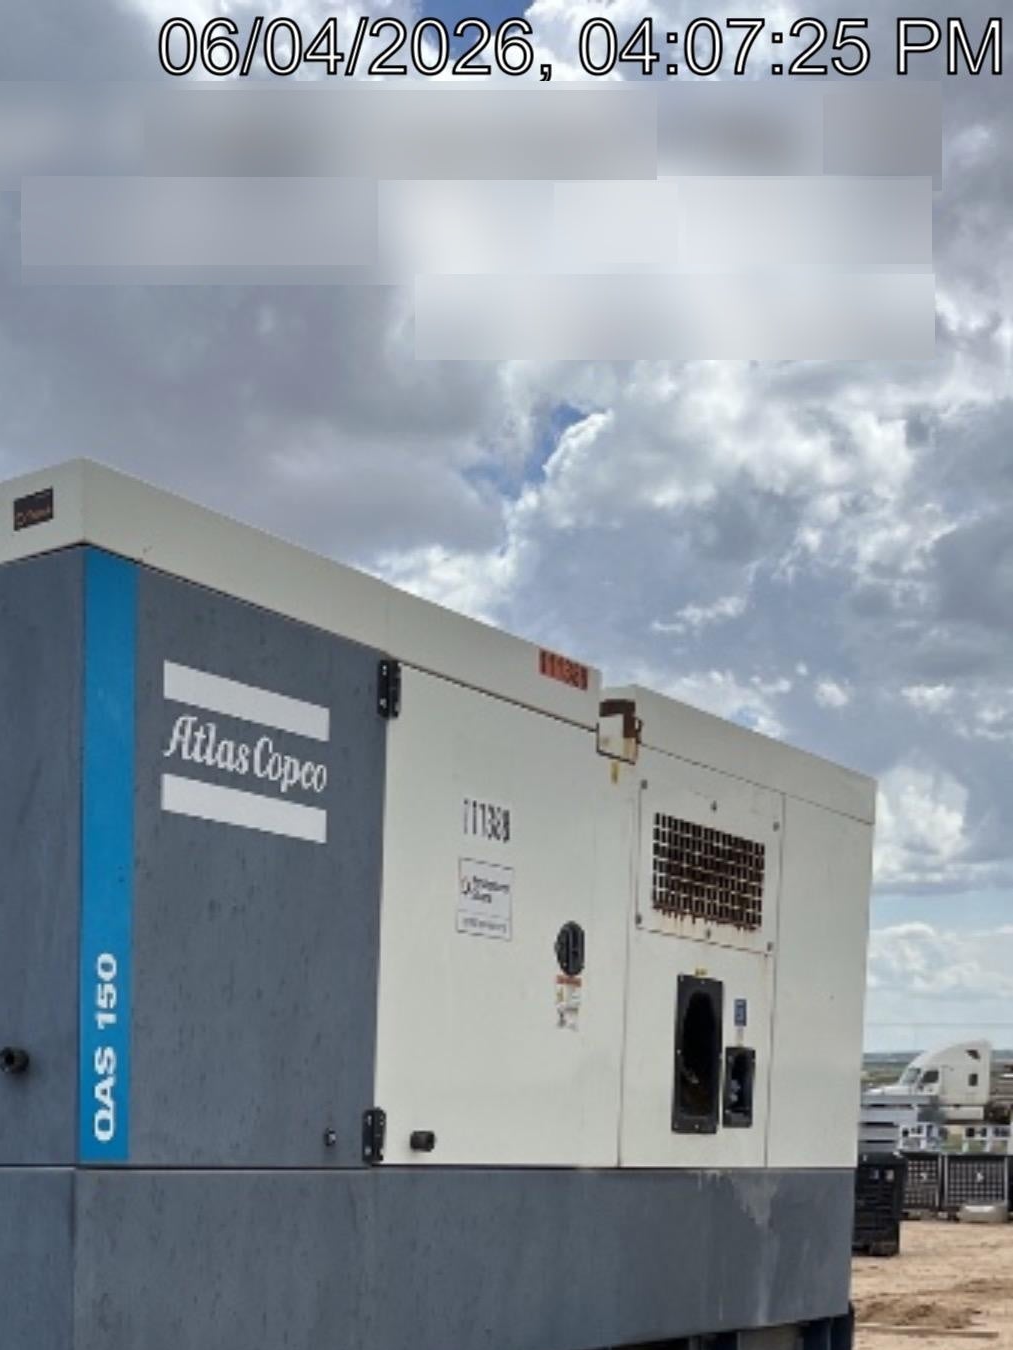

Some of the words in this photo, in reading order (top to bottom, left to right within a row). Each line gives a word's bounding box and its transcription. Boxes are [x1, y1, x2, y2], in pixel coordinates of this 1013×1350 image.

[163, 714, 252, 776] Atlas
[252, 734, 328, 794] Copco
[95, 952, 118, 1031] 150
[93, 1046, 117, 1143] QAS
